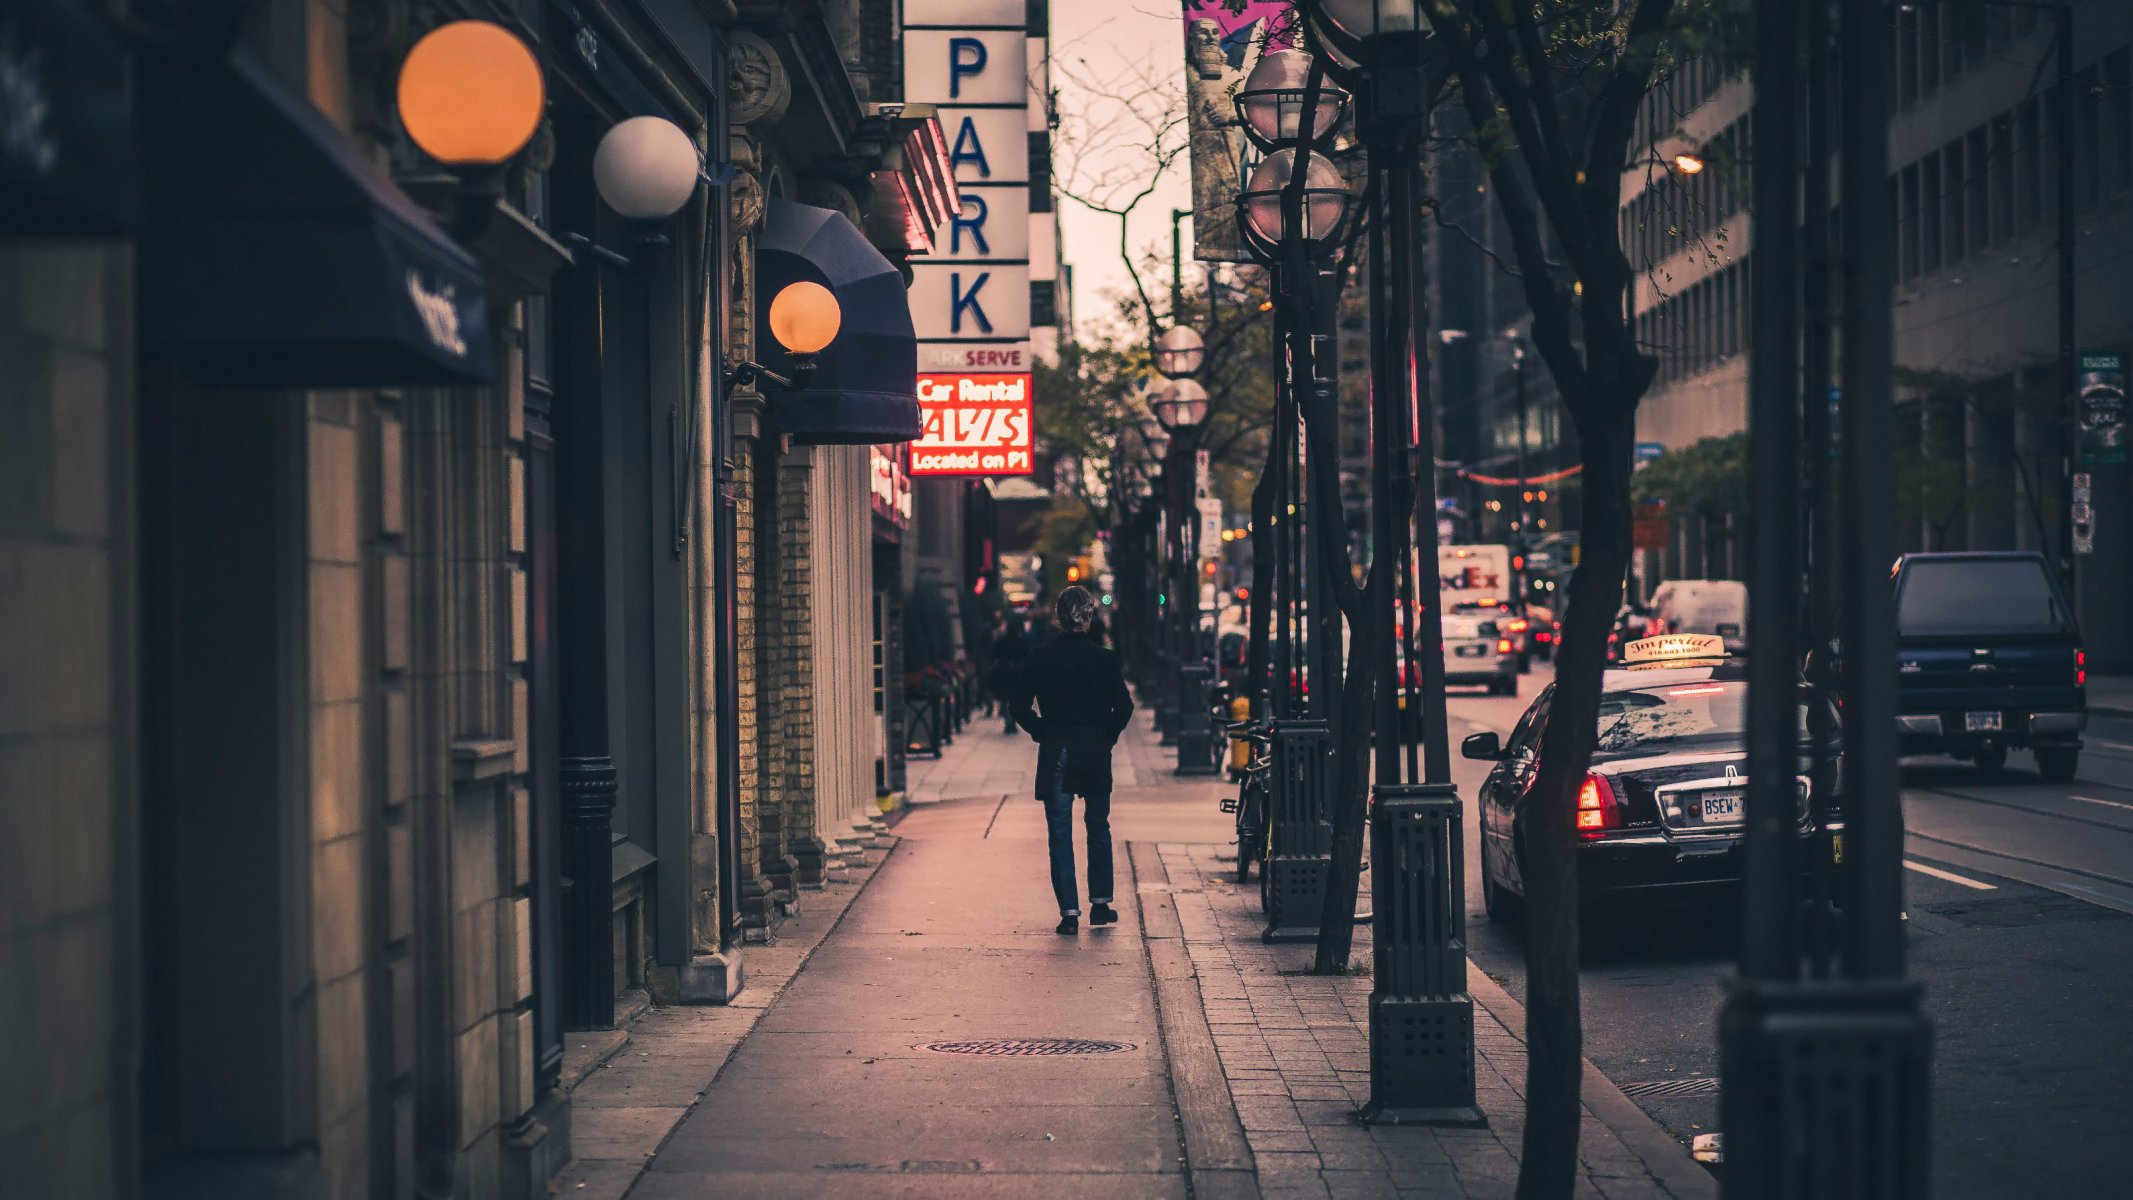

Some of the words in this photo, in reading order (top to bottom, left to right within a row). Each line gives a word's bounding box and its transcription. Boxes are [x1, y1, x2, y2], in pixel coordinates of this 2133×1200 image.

[949, 37, 993, 333] PARK
[926, 351, 1021, 367] ARKSERVE
[917, 379, 954, 402] Car
[959, 379, 1024, 402] Rental
[922, 408, 1023, 442] AVIS
[912, 451, 979, 469] Located
[982, 455, 1005, 469] on
[1007, 451, 1028, 468] P1
[1439, 567, 1499, 591] edEx
[1631, 637, 1716, 653] Imperial
[1705, 798, 1733, 815] BSEW
